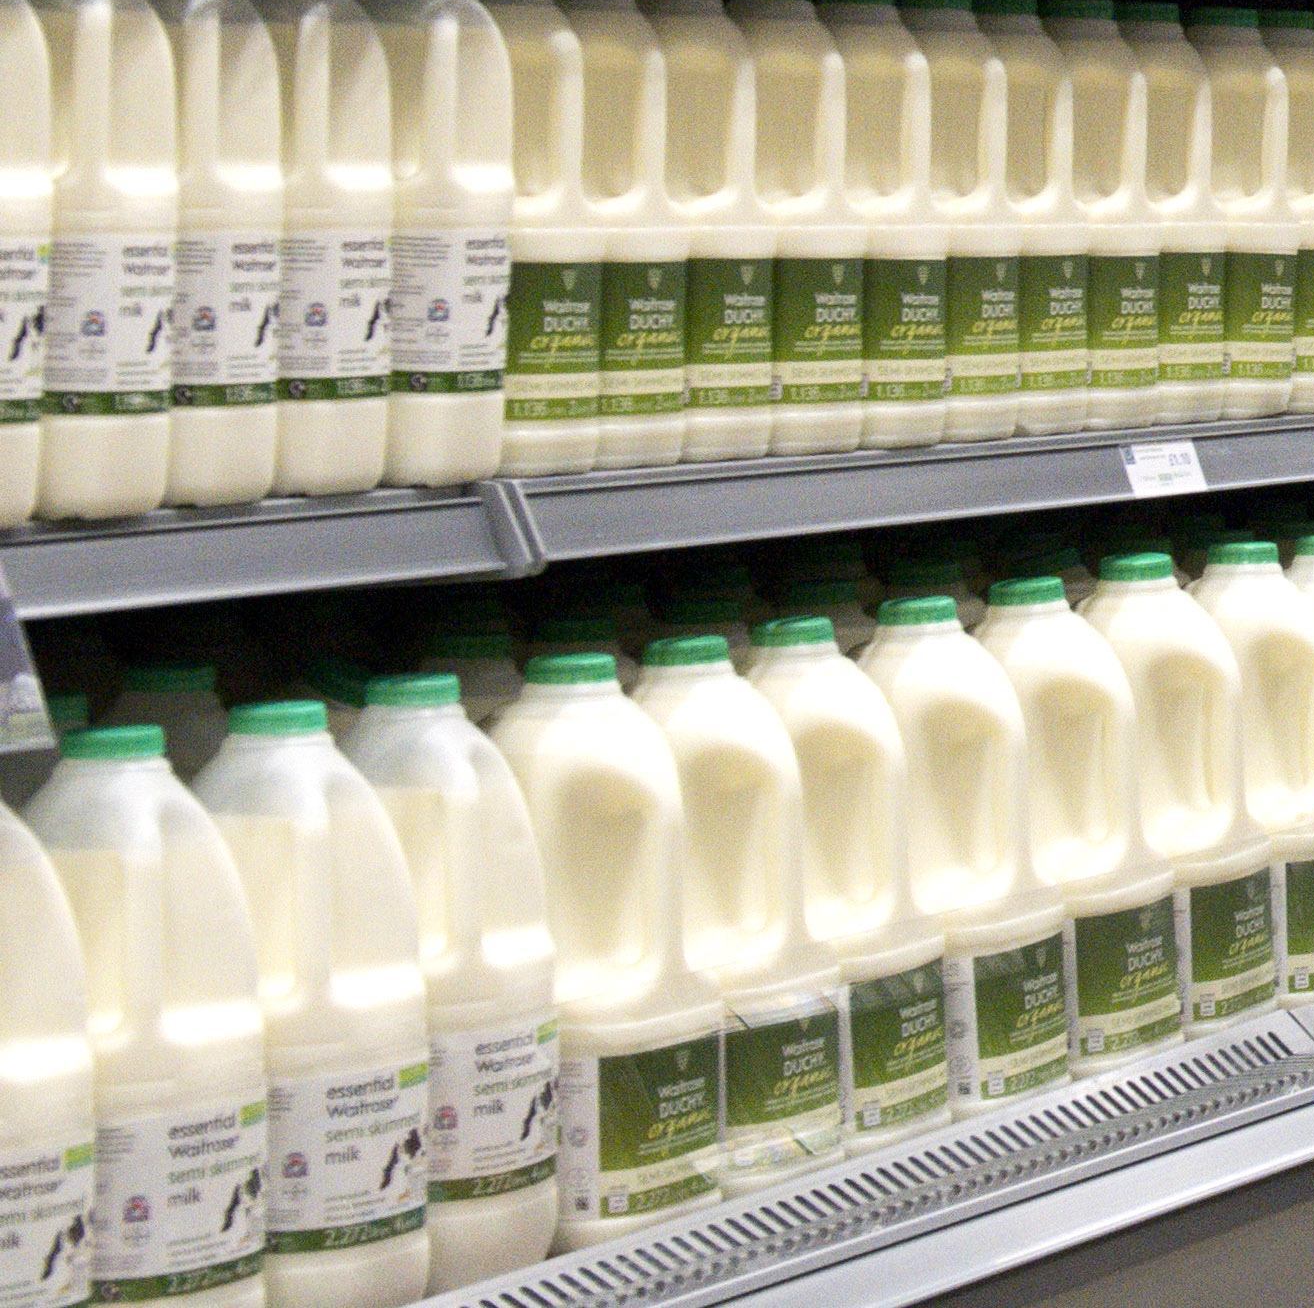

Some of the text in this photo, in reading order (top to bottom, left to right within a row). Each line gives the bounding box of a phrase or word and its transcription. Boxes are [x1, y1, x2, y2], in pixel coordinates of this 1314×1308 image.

[1127, 952, 1164, 973] DUCHY
[475, 1031, 535, 1056] essential
[783, 1054, 825, 1079] DUCHY
[326, 1073, 394, 1101] essential
[327, 1095, 399, 1121] Waitrose
[473, 1099, 505, 1118] milk
[659, 1096, 703, 1121] DUCHY
[168, 1112, 236, 1140] essential
[0, 1153, 61, 1180] ssential
[325, 1145, 361, 1166] milk
[0, 1178, 63, 1203] aitrose
[167, 1187, 201, 1208] milk
[0, 1232, 20, 1251] ilk
